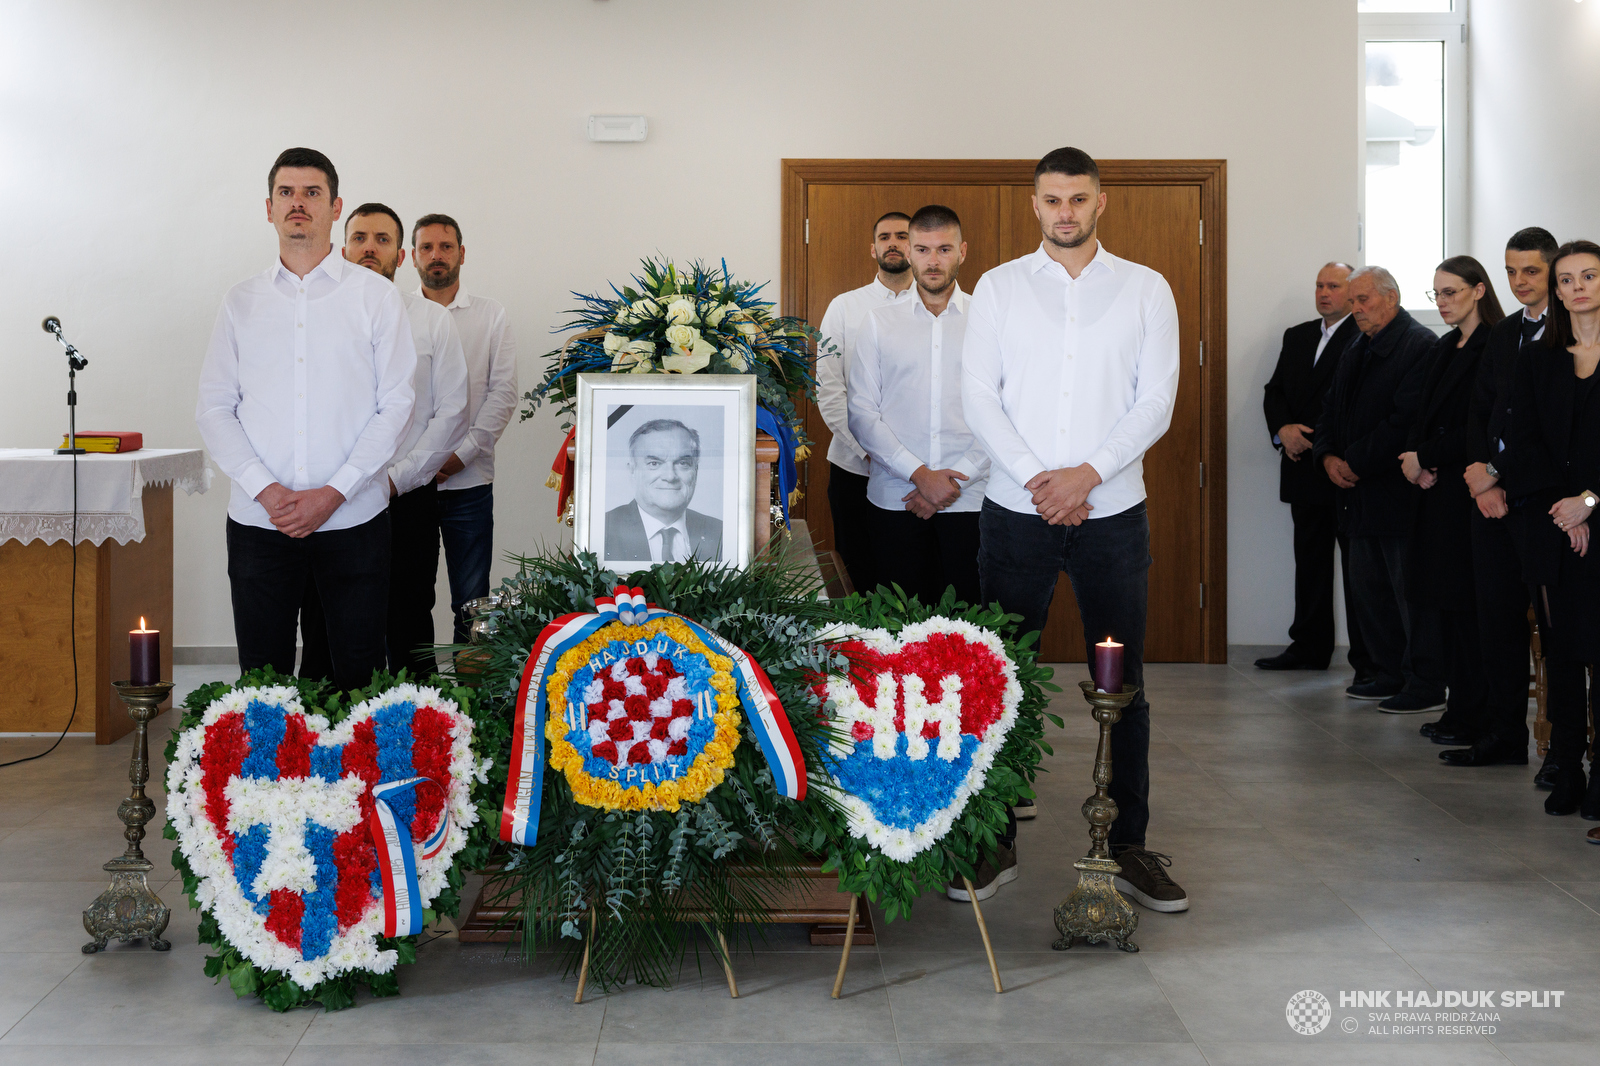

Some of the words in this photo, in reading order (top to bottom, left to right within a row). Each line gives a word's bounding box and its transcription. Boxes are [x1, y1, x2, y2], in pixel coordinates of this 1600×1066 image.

[588, 640, 688, 672] HAJDUK
[825, 671, 964, 763] NH
[608, 764, 679, 783] SPLIT
[223, 771, 366, 901] T
